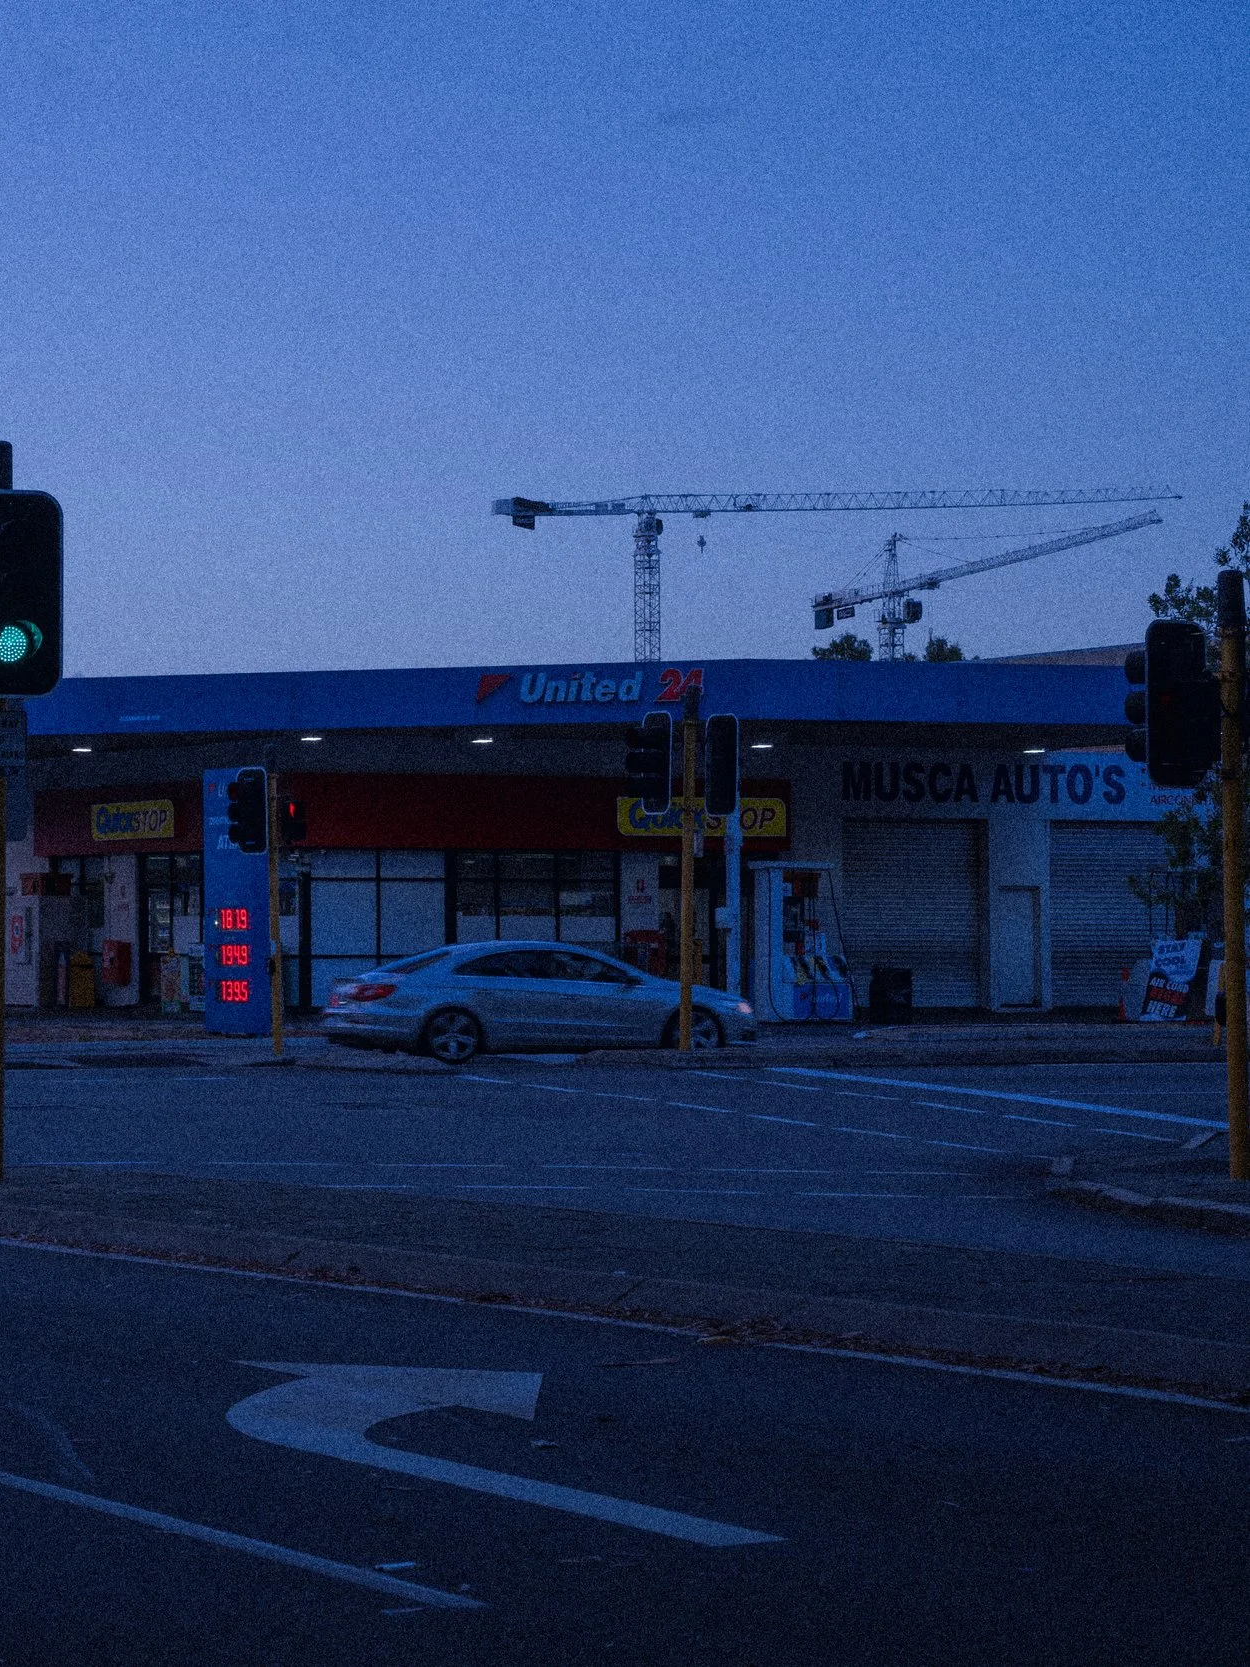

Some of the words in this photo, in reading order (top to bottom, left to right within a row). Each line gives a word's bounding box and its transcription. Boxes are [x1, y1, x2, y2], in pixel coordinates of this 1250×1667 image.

[520, 671, 643, 703] United
[656, 667, 704, 703] 24
[841, 761, 979, 803] MUSCA
[990, 763, 1126, 805] AUTO'S
[1146, 1000, 1178, 1018] HERE
